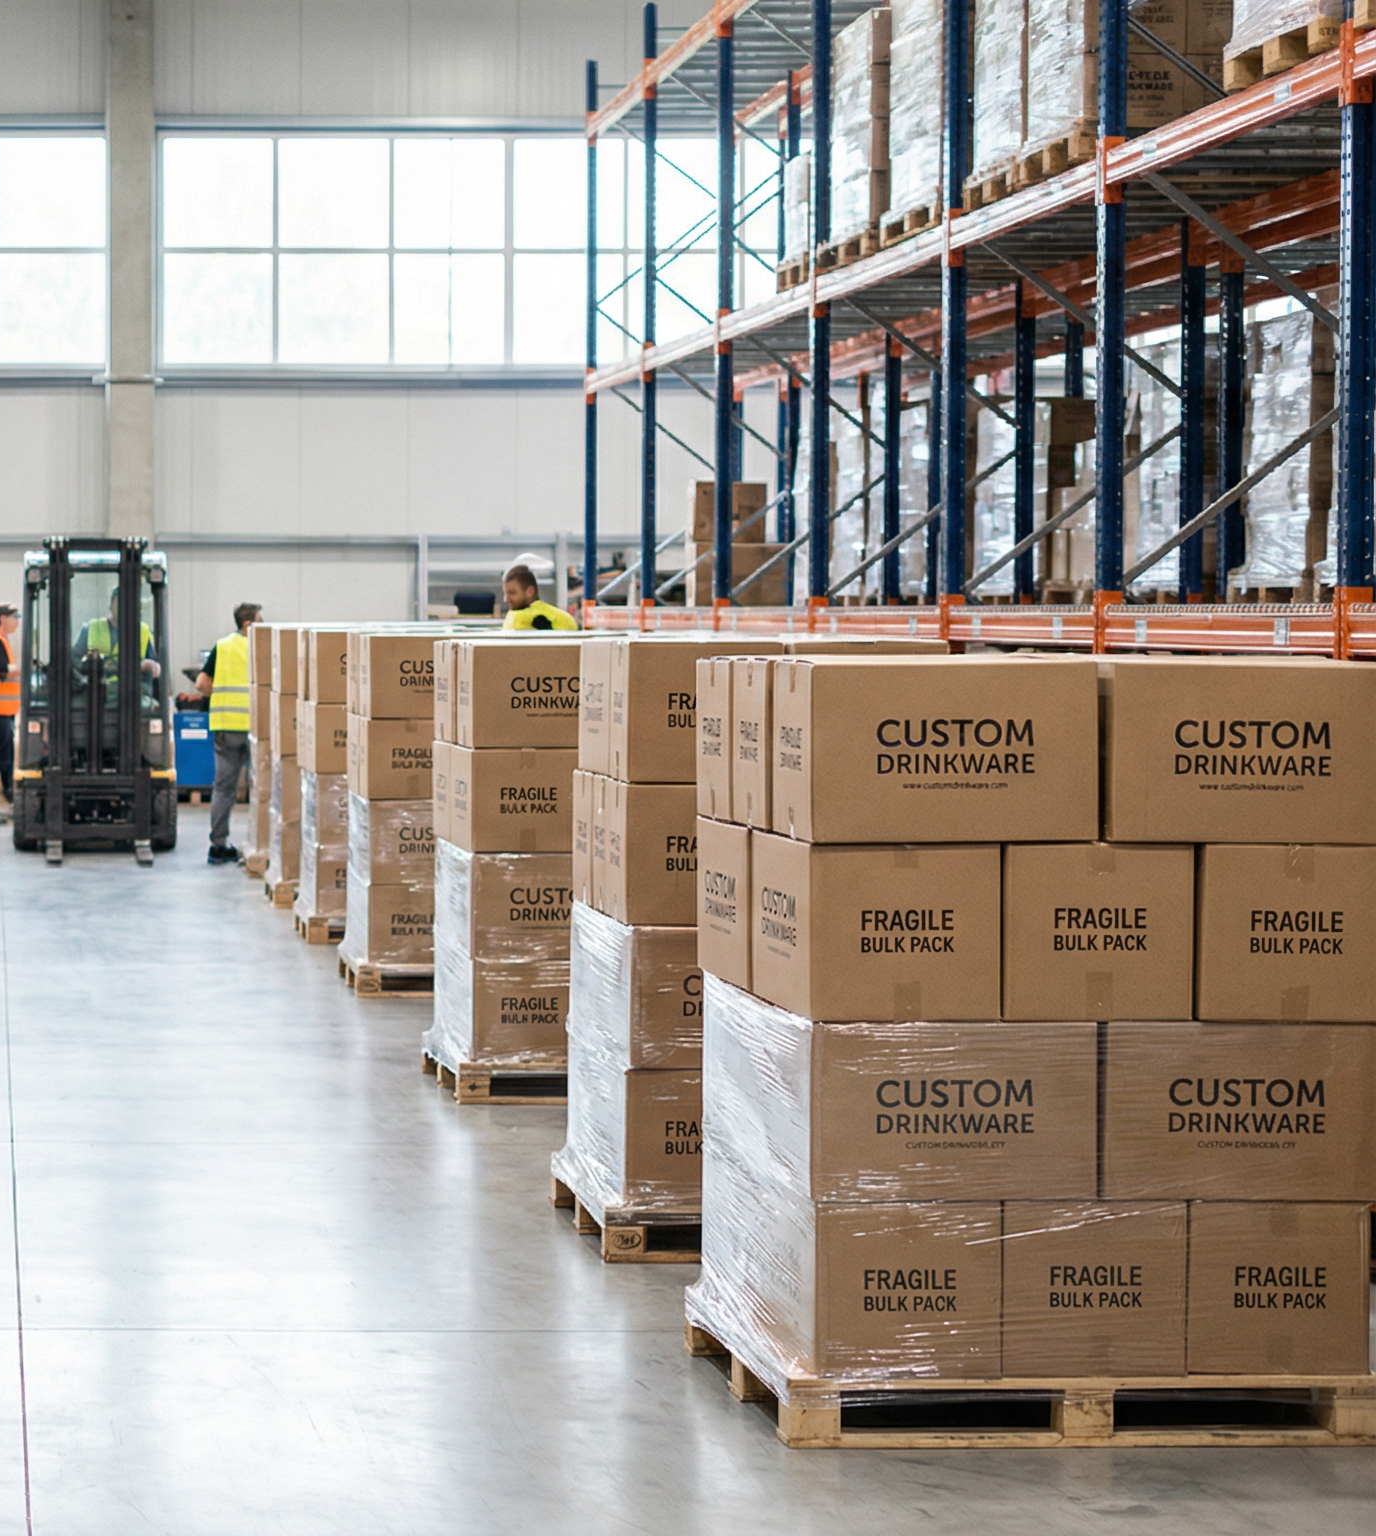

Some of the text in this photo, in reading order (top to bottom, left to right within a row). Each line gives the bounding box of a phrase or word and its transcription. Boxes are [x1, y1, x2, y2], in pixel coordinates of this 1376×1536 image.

[877, 719, 1034, 747] CUSTOM
[1175, 720, 1331, 749] CUSTOM
[878, 753, 1035, 774] DRINKWARE
[1175, 754, 1331, 776] DRINKWARE
[501, 787, 557, 801] FRAGILE
[531, 804, 557, 813] PACK
[862, 910, 954, 931] FRAGILE
[1055, 908, 1146, 929] FRAGILE
[1251, 911, 1343, 932] FRAGILE
[861, 937, 954, 953] BULK PACK
[1054, 935, 1146, 951] BULK PACK
[1250, 937, 1343, 954] BULK PACK
[502, 997, 558, 1010] FRAGILE
[532, 1013, 558, 1024] PACK
[876, 1079, 1033, 1108] CUSTOM
[1169, 1078, 1325, 1107] CUSTOM
[877, 1113, 1034, 1134] DRINKWARE
[1169, 1113, 1325, 1134] DRINKWARE
[864, 1269, 956, 1290] FRAGILE
[1050, 1266, 1142, 1286] FRAGILE
[1235, 1266, 1326, 1287] FRAGILE
[864, 1296, 956, 1311] BULK PACK
[1050, 1292, 1142, 1308] BULK PACK
[1234, 1293, 1326, 1309] BULK PACK
